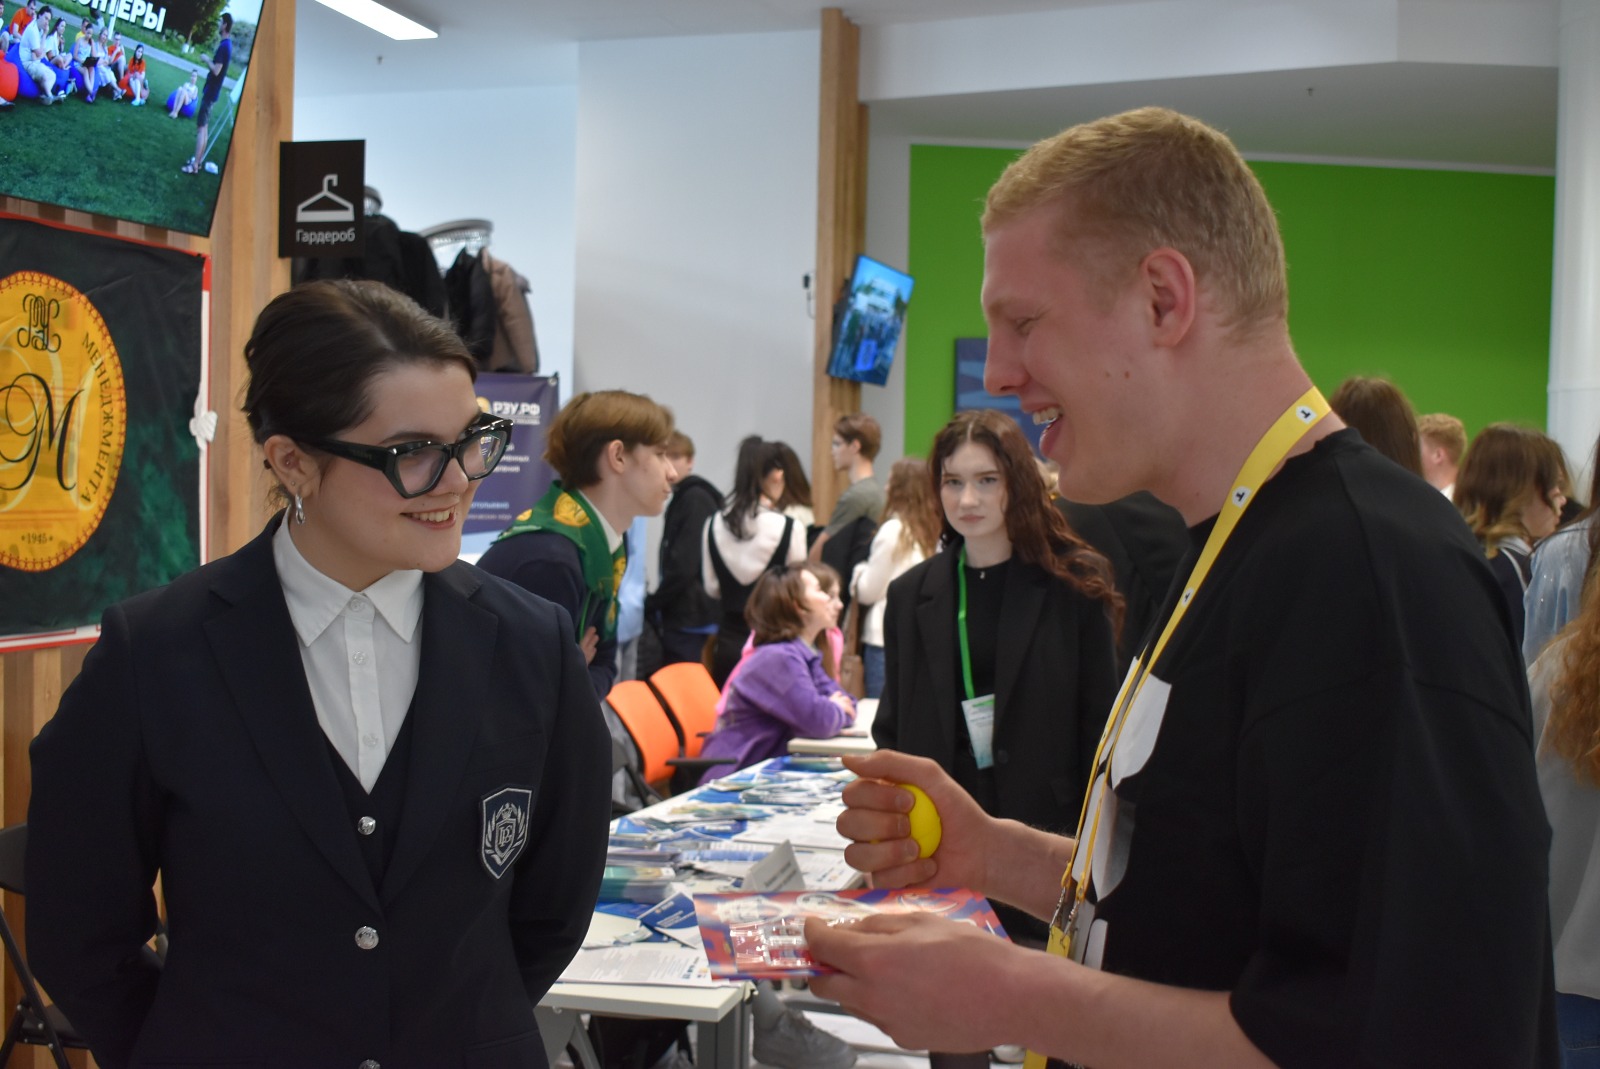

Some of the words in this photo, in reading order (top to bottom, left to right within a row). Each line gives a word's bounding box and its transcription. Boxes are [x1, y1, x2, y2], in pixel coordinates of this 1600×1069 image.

[72, 0, 167, 33] НТЕРЫ
[295, 227, 356, 246] Гардероб
[81, 331, 114, 502] МЕНЕДЖМЕНТА
